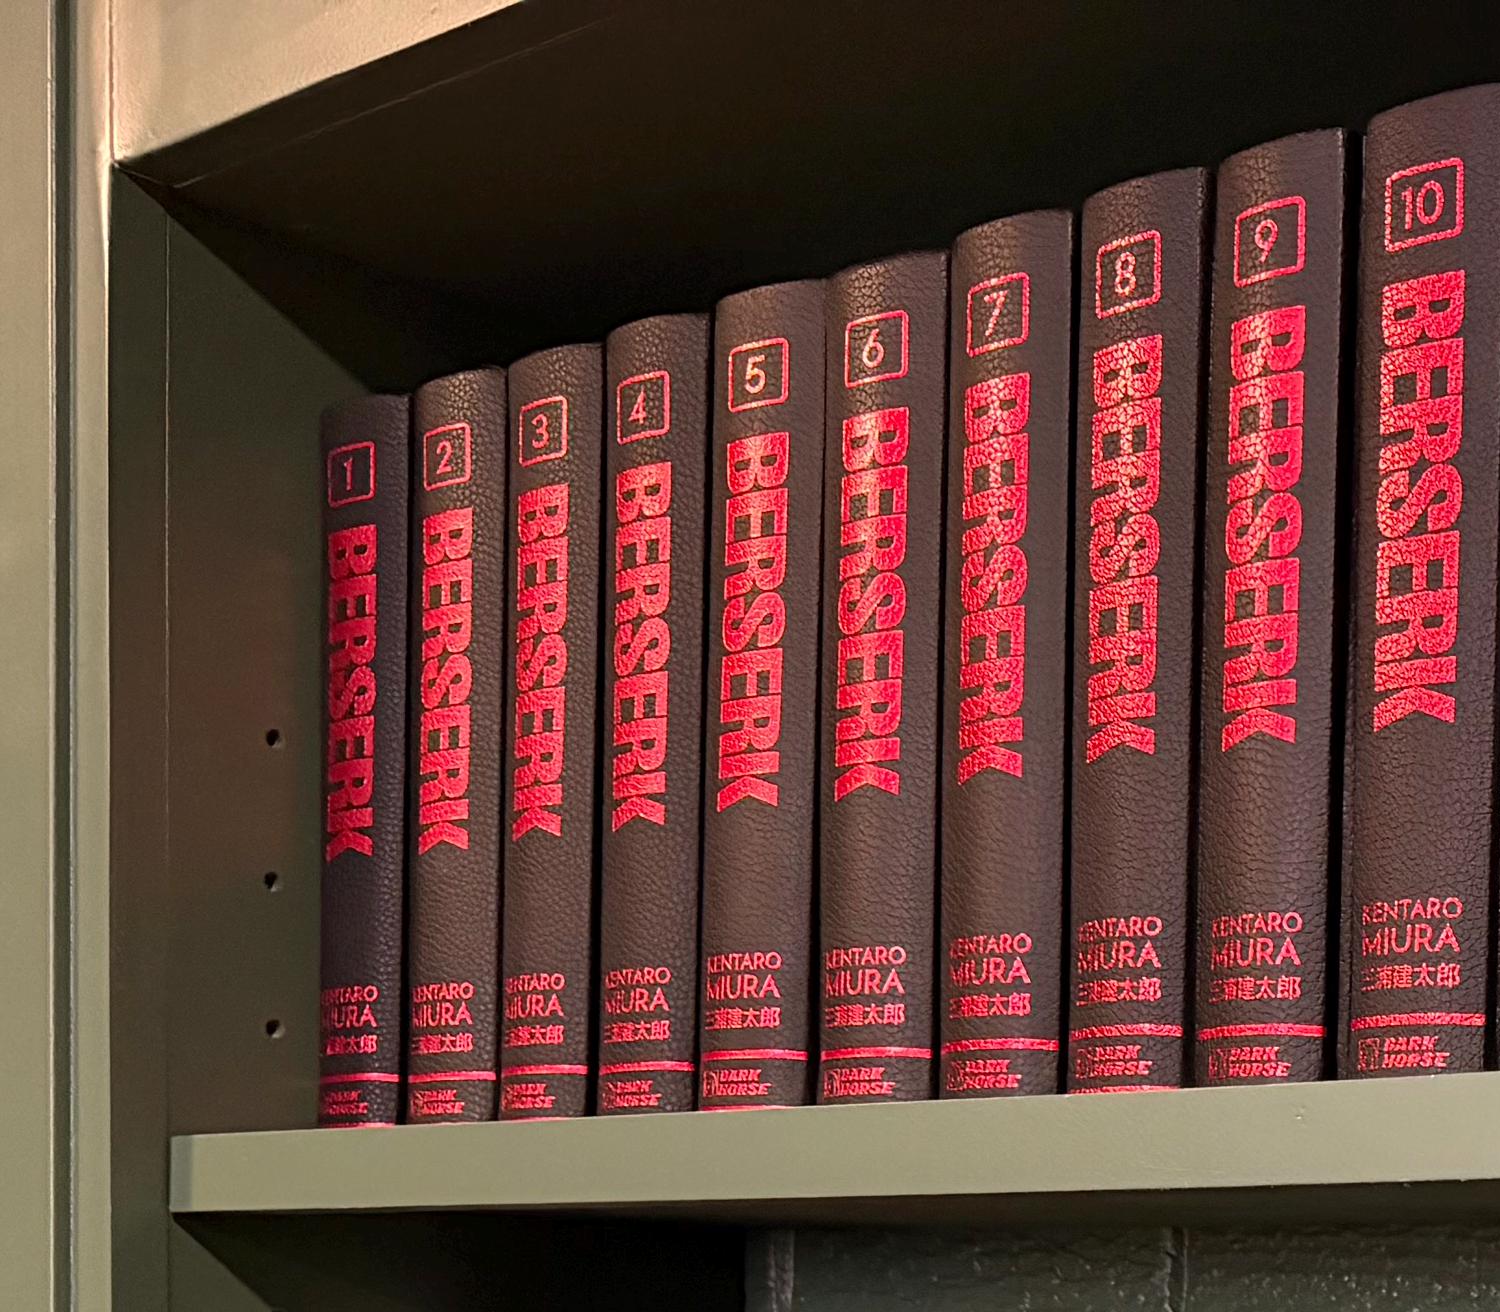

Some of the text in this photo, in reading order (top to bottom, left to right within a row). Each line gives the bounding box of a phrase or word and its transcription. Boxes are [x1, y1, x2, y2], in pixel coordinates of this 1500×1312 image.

[1401, 180, 1444, 230] 10
[1254, 219, 1278, 263] 9
[1114, 251, 1135, 295] 8
[984, 293, 1008, 334] 7
[863, 331, 885, 365] 6
[745, 358, 766, 392] 5
[628, 393, 647, 424] 4
[531, 413, 549, 449] 3
[436, 440, 452, 474] 2
[343, 458, 353, 491] 1
[1372, 269, 1467, 733] BERSERK
[1221, 304, 1307, 752] BERSERK
[1085, 333, 1165, 764] BERSERK
[956, 371, 1032, 785] BERSERK
[834, 405, 911, 803] BERSERK
[716, 430, 791, 813] BERSERK
[512, 481, 570, 841] BERSERK
[611, 460, 673, 832] BERSERK
[327, 523, 378, 860] BERSERK
[418, 506, 476, 855] BERSERK
[1211, 911, 1303, 939] KENTARO
[1362, 897, 1463, 925] KENTARO
[1078, 916, 1163, 942] KENTARO
[1362, 923, 1461, 956] MIURA
[707, 951, 782, 973] KENTARO
[825, 946, 907, 969] KENTARO
[1078, 940, 1162, 973] MIURA
[1210, 937, 1302, 969] MIURA
[707, 974, 782, 1000] MIURA
[825, 968, 905, 998] MIURA
[950, 956, 1031, 986] MIURA
